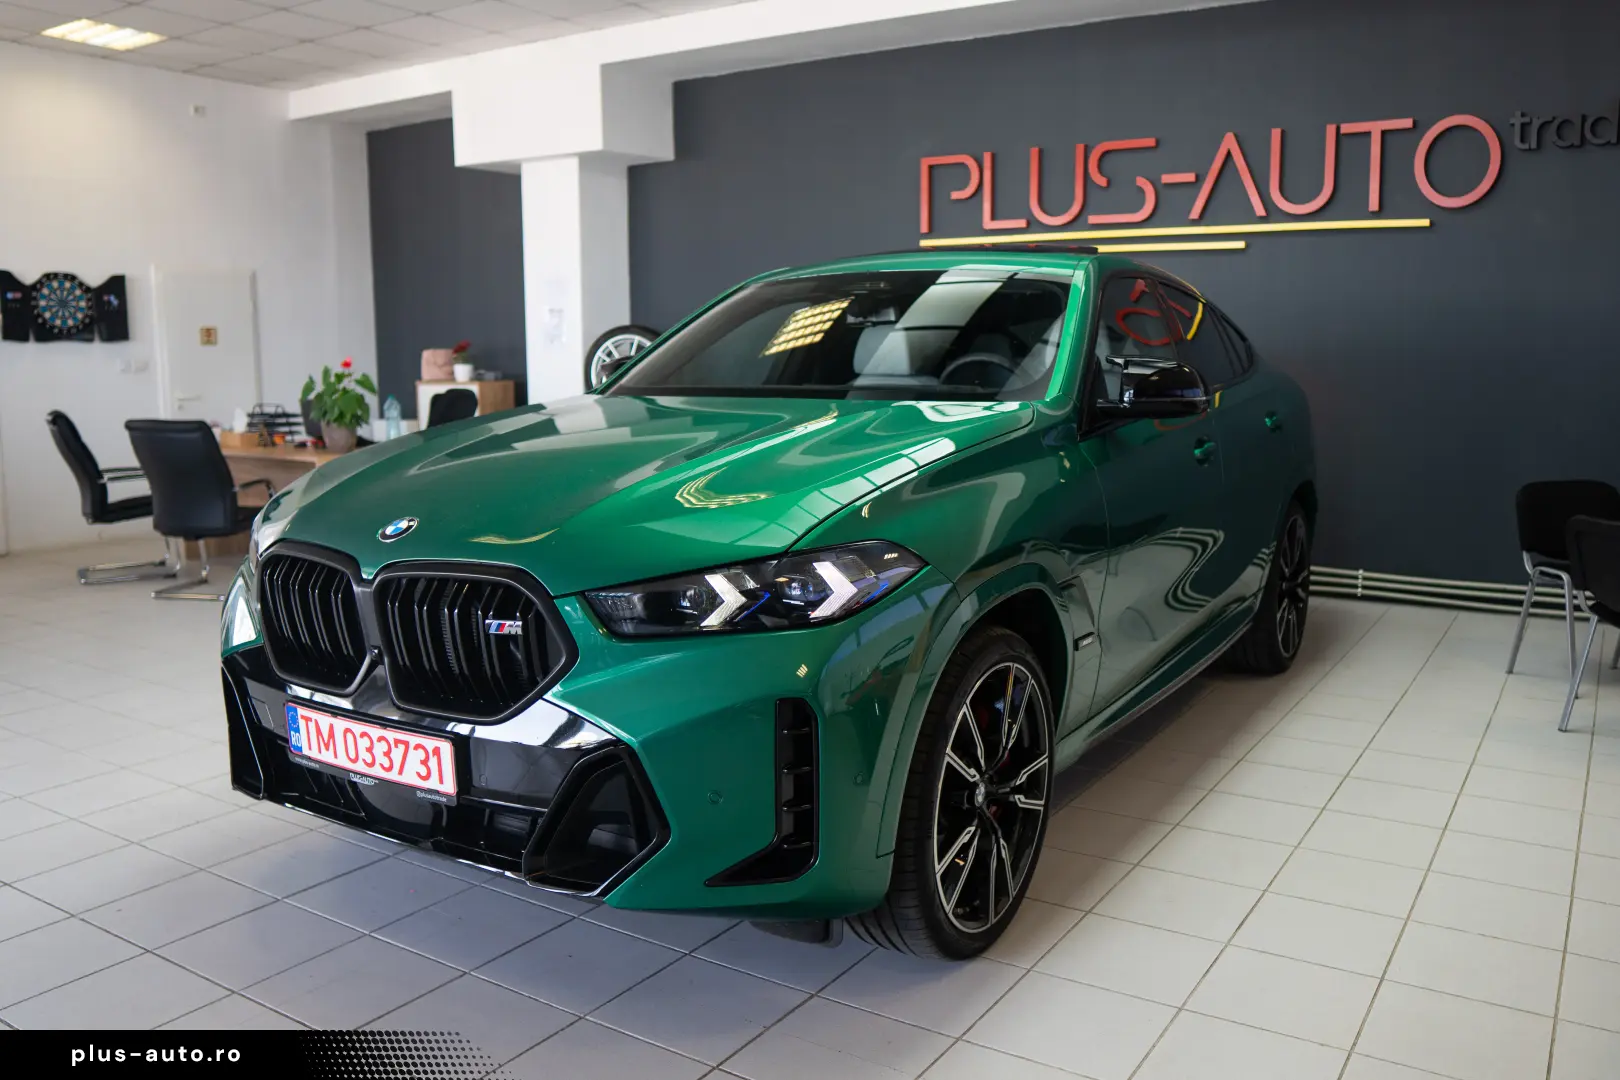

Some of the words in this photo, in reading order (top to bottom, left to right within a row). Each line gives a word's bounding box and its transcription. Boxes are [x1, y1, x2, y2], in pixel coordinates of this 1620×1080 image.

[919, 113, 1502, 234] PLUS-AUTO
[291, 731, 302, 747] RO
[300, 715, 338, 759] TM
[343, 727, 444, 785] 033731
